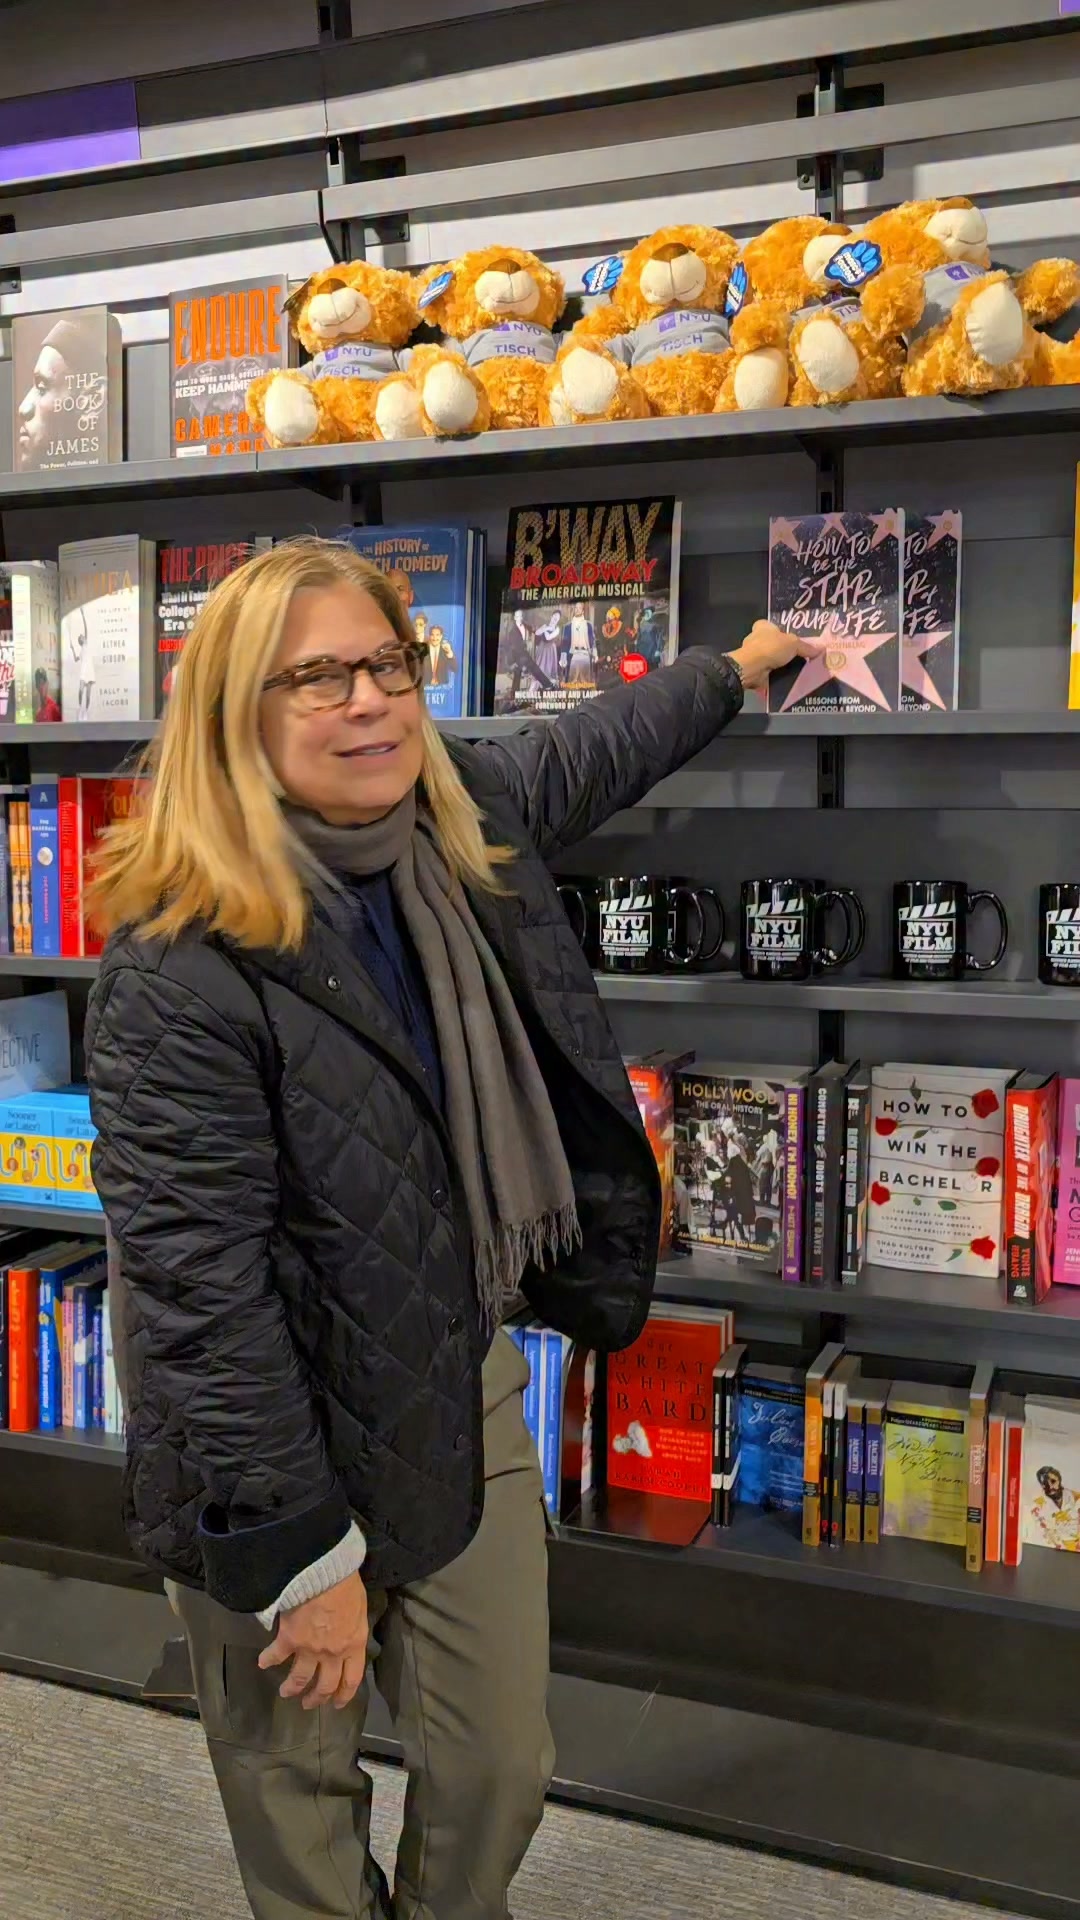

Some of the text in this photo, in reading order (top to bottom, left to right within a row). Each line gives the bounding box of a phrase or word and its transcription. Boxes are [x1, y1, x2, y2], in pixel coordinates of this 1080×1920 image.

[174, 286, 282, 366] ENDURE
[679, 313, 711, 323] NYU
[513, 323, 542, 336] NYU
[342, 346, 372, 357] NYU
[494, 344, 536, 356] TISCH
[65, 372, 99, 389] THE
[175, 379, 252, 398] KEEP HAMME
[53, 394, 99, 412] BOOK
[77, 415, 98, 431] OF
[46, 437, 99, 456] JAMES
[374, 537, 422, 556] HISTORY
[514, 502, 663, 572] B'WAY
[792, 531, 871, 567] HOW TO
[160, 546, 193, 585] THE
[394, 554, 449, 573] COMEDY
[510, 558, 658, 590] BROADWAY
[521, 582, 645, 600] THE AMERICAN MUSICAL
[794, 568, 874, 613] STAR
[158, 605, 196, 619] College
[164, 619, 185, 632] Era
[780, 605, 887, 639] YOUR LIFE
[902, 608, 942, 638] FE
[839, 696, 860, 705] FROM
[846, 704, 876, 713] BEYOND
[604, 915, 645, 929] NYU
[755, 919, 797, 934] NYU
[906, 921, 950, 937] NYU
[602, 928, 649, 944] FILM
[750, 933, 800, 949] FILM
[903, 936, 953, 951] FILM
[1051, 940, 1080, 954] FIL
[682, 1082, 778, 1105] HOLLYWOOD
[787, 1093, 798, 1104] HI
[696, 1100, 764, 1114] THE ORAL HISTORY
[817, 1088, 827, 1142] COMPETING
[883, 1100, 968, 1118] HOW TO
[786, 1107, 798, 1144] HONEY,
[1012, 1103, 1031, 1161] DAUGHTER
[887, 1139, 977, 1158] WIN THE
[786, 1165, 797, 1199] HOMO!
[815, 1160, 824, 1193] IDIOTS
[1013, 1191, 1031, 1239] DRAGON
[615, 1353, 705, 1374] GREAT
[615, 1372, 706, 1397] WHITE
[615, 1392, 706, 1421] BARD
